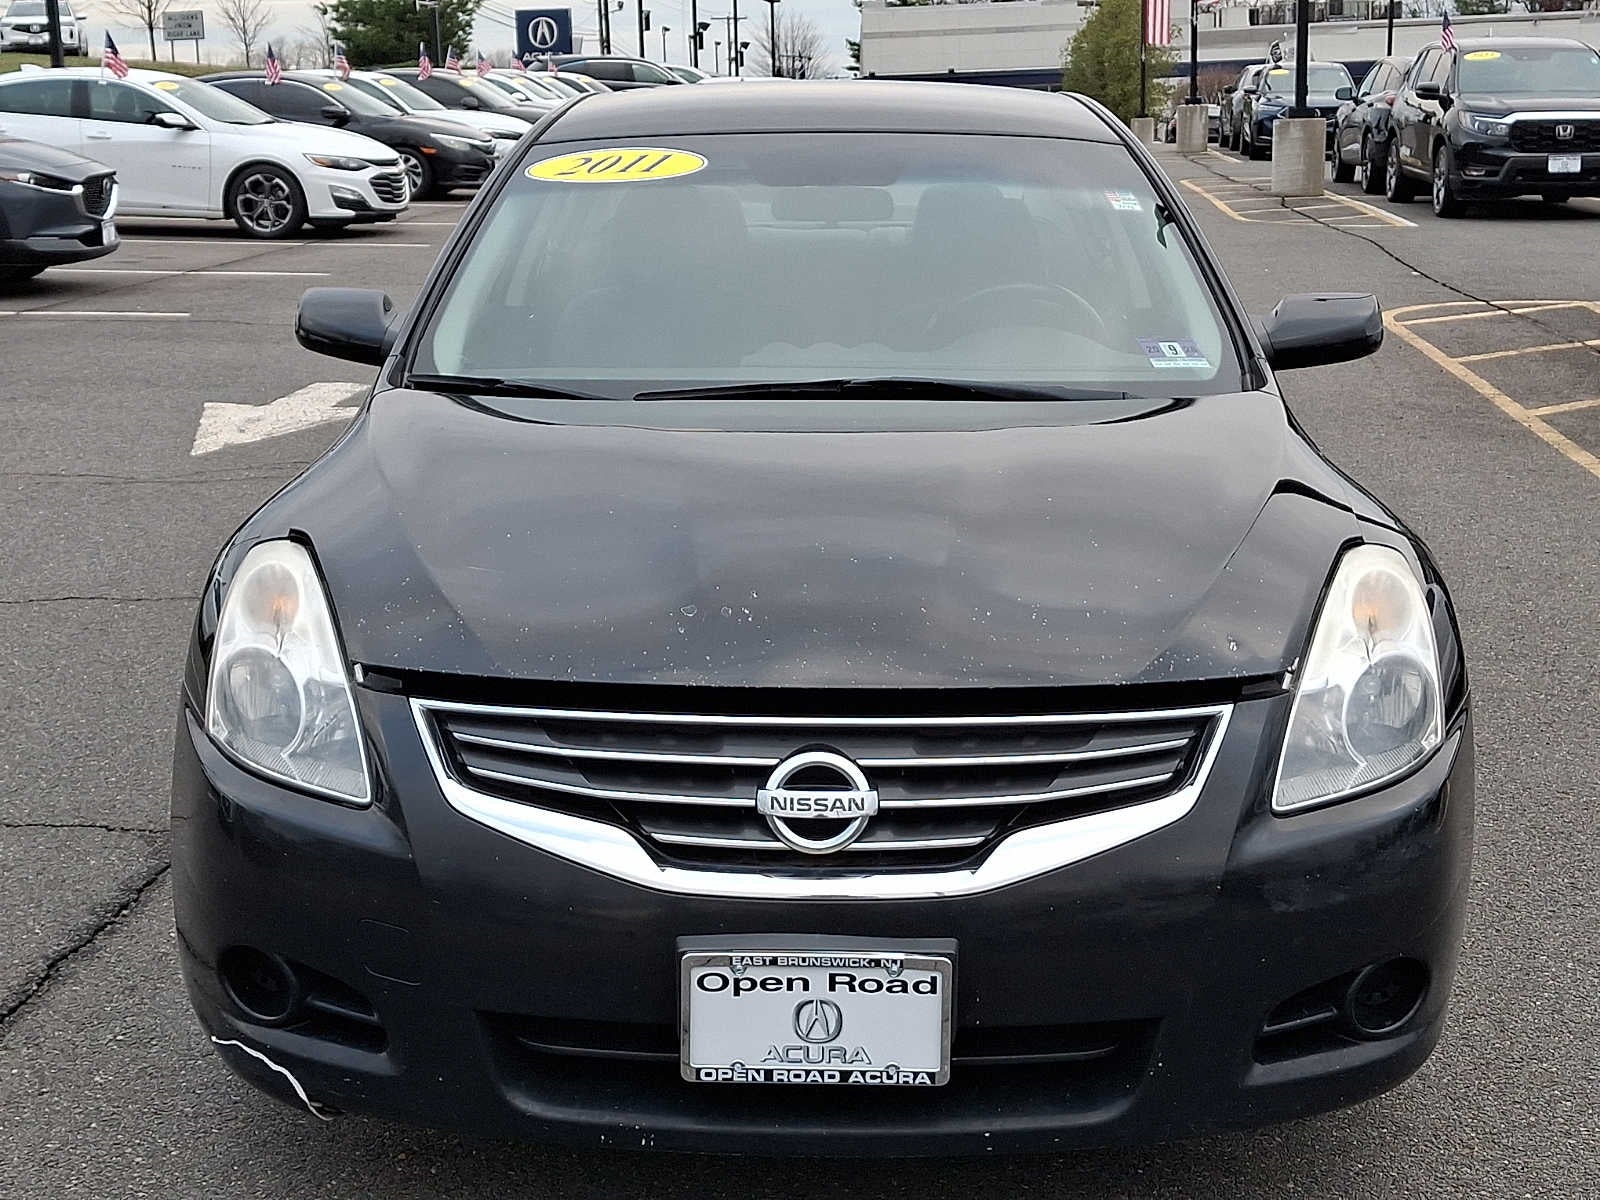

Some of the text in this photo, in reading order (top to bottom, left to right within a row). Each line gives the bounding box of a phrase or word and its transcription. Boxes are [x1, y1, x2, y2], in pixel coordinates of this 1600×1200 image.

[554, 154, 672, 176] 2011
[1167, 344, 1179, 356] 9
[770, 796, 865, 812] NISSAN
[731, 956, 773, 967] EAST
[696, 972, 938, 997] Open Road
[760, 1045, 872, 1064] ACURA
[699, 1068, 932, 1085] OPEN ROAD ACURA
